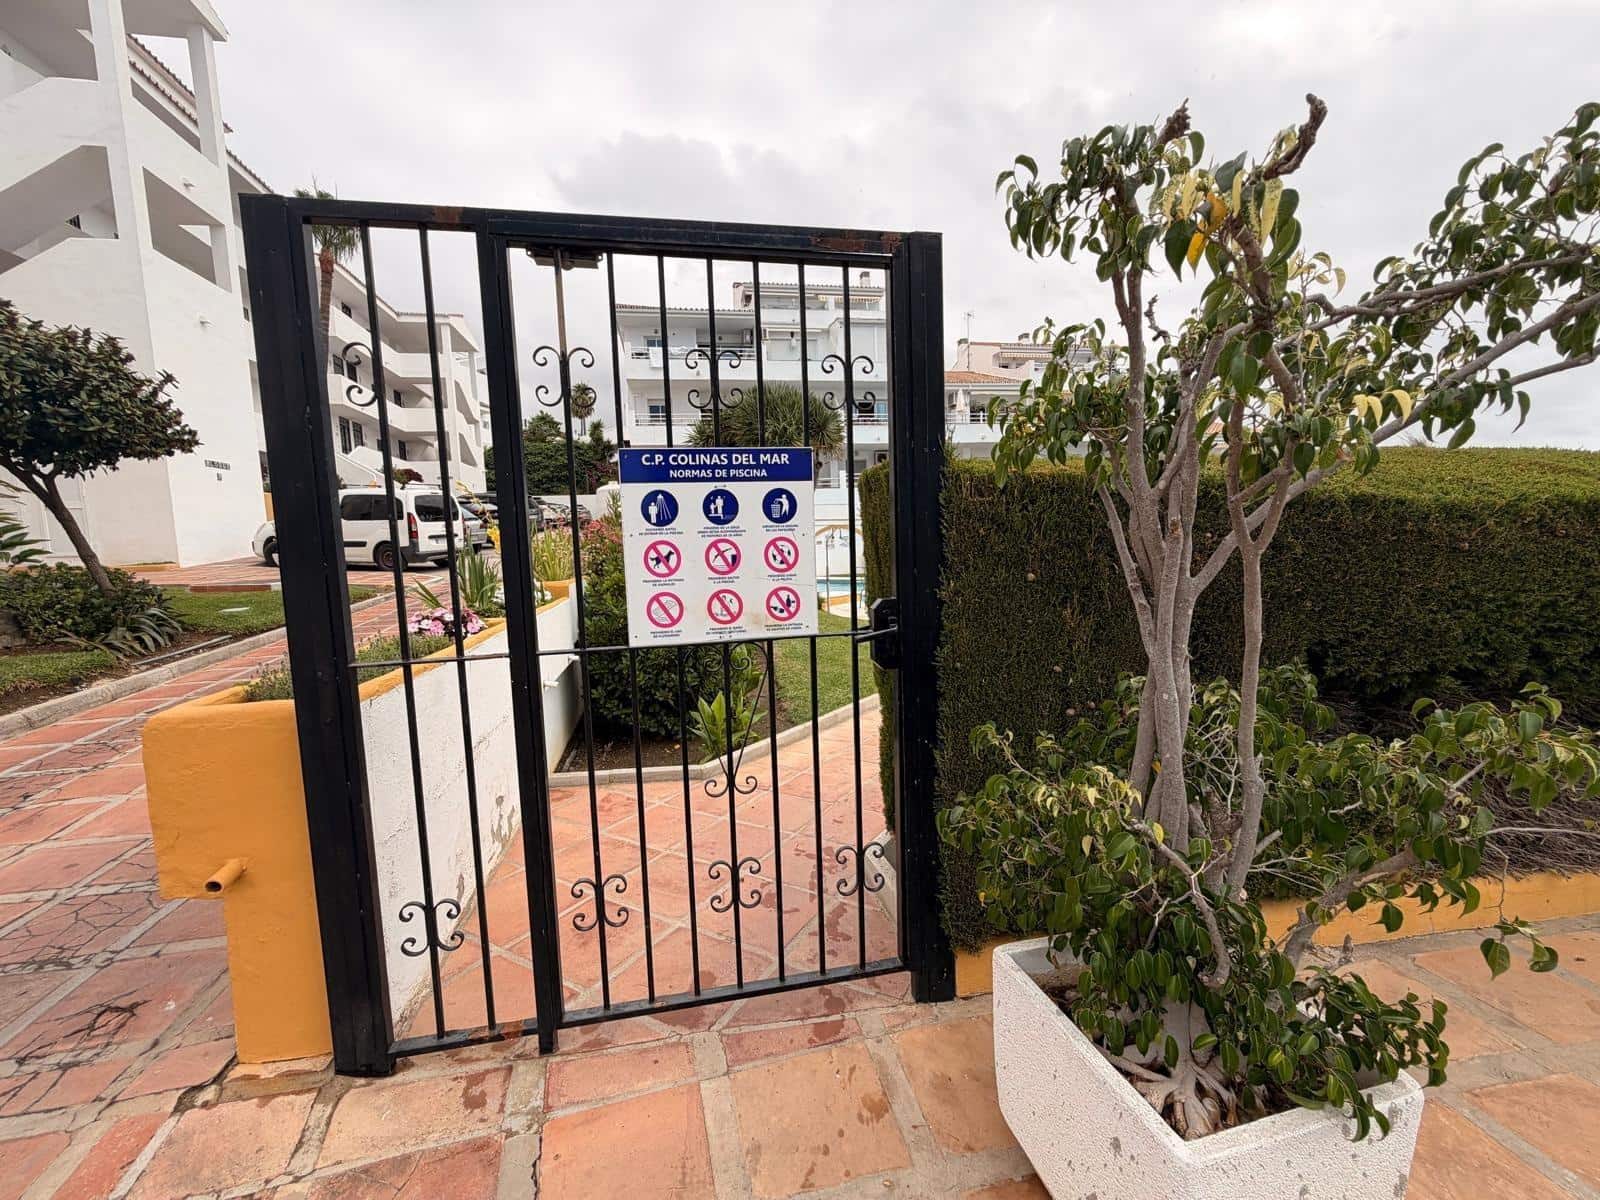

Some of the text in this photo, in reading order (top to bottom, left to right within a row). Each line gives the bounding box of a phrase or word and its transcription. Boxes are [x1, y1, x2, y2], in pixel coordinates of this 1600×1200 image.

[641, 453, 790, 465] C.P. COLINAS DEL MAR
[669, 468, 768, 478] NORMAS DE PISCINA
